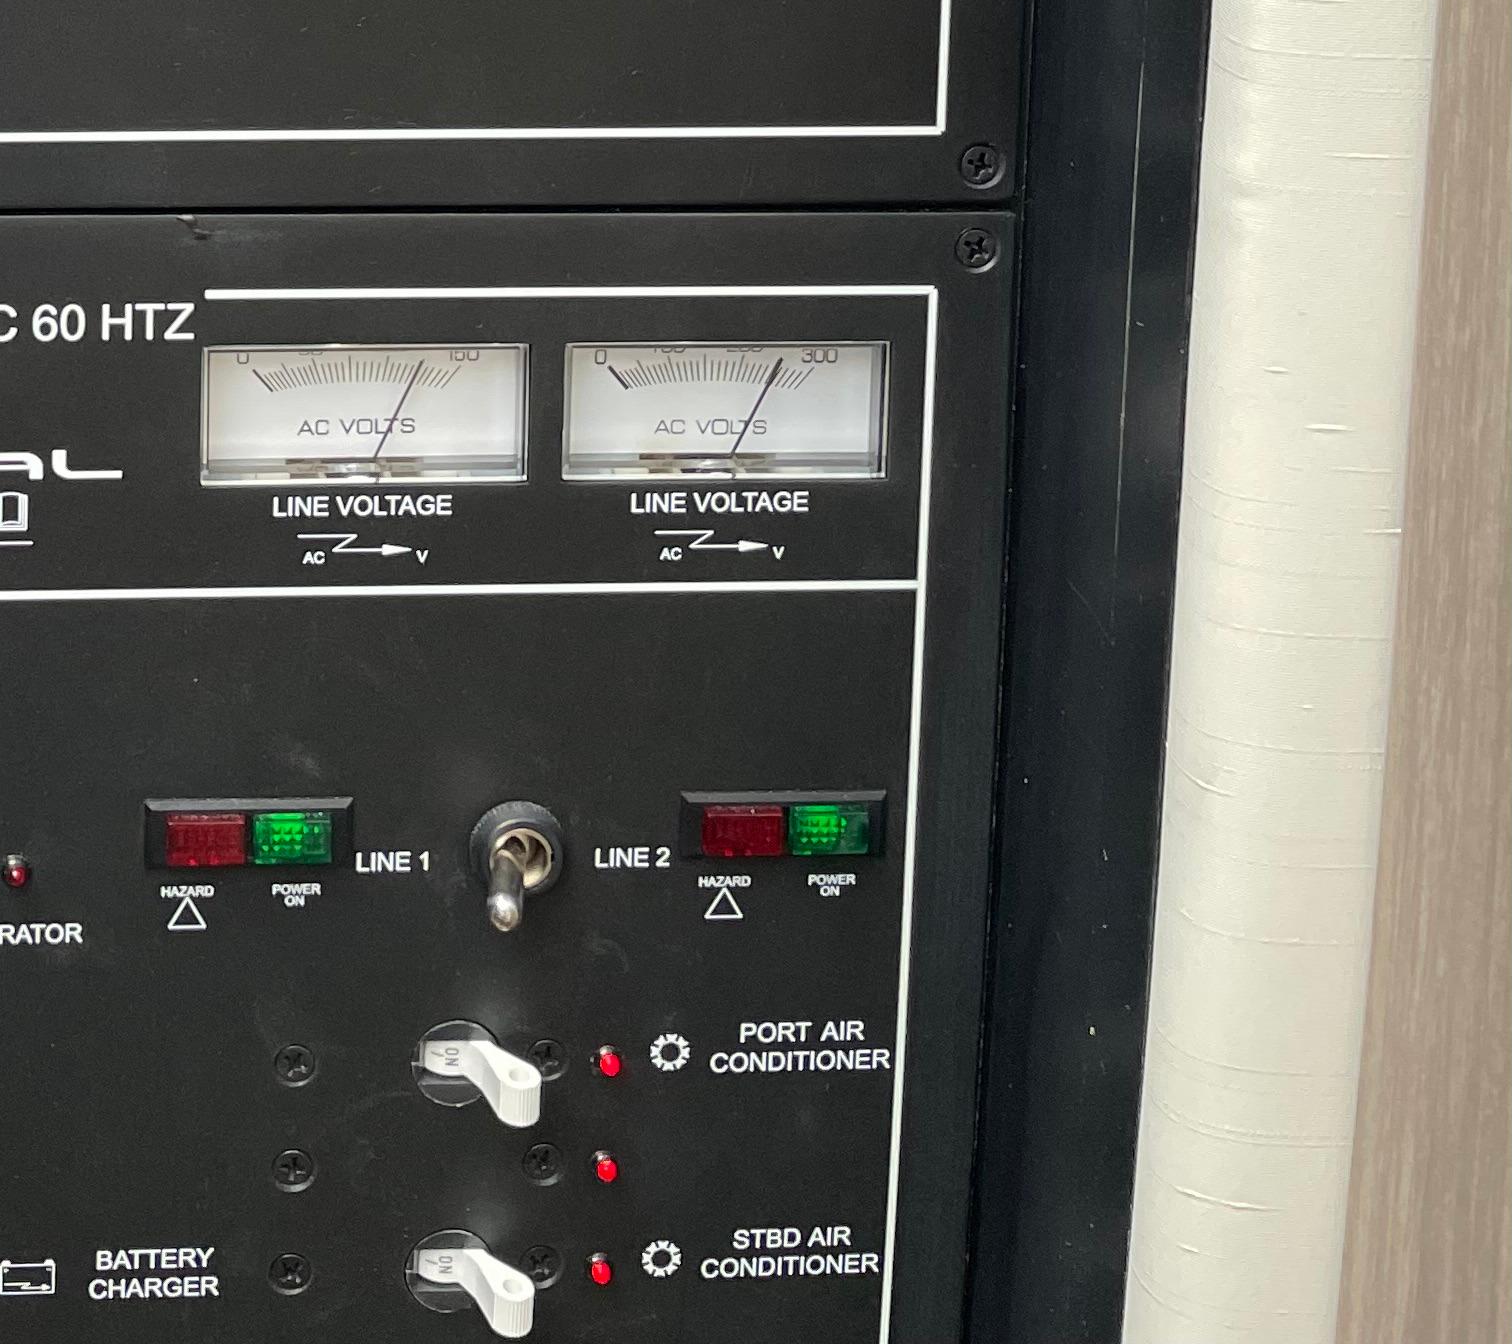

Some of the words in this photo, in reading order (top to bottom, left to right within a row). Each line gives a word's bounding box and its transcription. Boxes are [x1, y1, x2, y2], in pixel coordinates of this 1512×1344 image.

[32, 303, 86, 342] 60
[101, 302, 195, 341] HTZ
[595, 349, 607, 365] 0
[801, 348, 837, 363] 300
[297, 420, 329, 435] AC
[339, 418, 415, 434] VOLTS
[655, 420, 685, 435] AC
[696, 419, 767, 435] VOLTS
[272, 495, 330, 518] LINE
[335, 494, 453, 517] VOLTAGE
[630, 492, 687, 514] LINE
[692, 490, 810, 513] VOLTAGE
[302, 550, 326, 565] AC
[415, 549, 429, 564] V
[659, 546, 683, 561] AC
[772, 545, 785, 560] V
[355, 850, 412, 873] LINE
[419, 850, 430, 872] 1
[594, 846, 650, 869] LINE
[655, 846, 671, 868] 2
[271, 882, 322, 896] POWER
[698, 875, 752, 888] HAZARD
[807, 873, 856, 886] POWER
[160, 885, 215, 898] HAZARD
[284, 894, 305, 907] ON
[819, 885, 840, 897] ON
[739, 1021, 813, 1044] PORT
[819, 1020, 865, 1042] AIR
[709, 1048, 891, 1074] CONDITIONER
[732, 1227, 802, 1248] STBD
[807, 1225, 851, 1247] AIR
[95, 1247, 215, 1271] BATTERY
[700, 1253, 880, 1279] CONDITIONER
[88, 1275, 220, 1300] CHARGER
